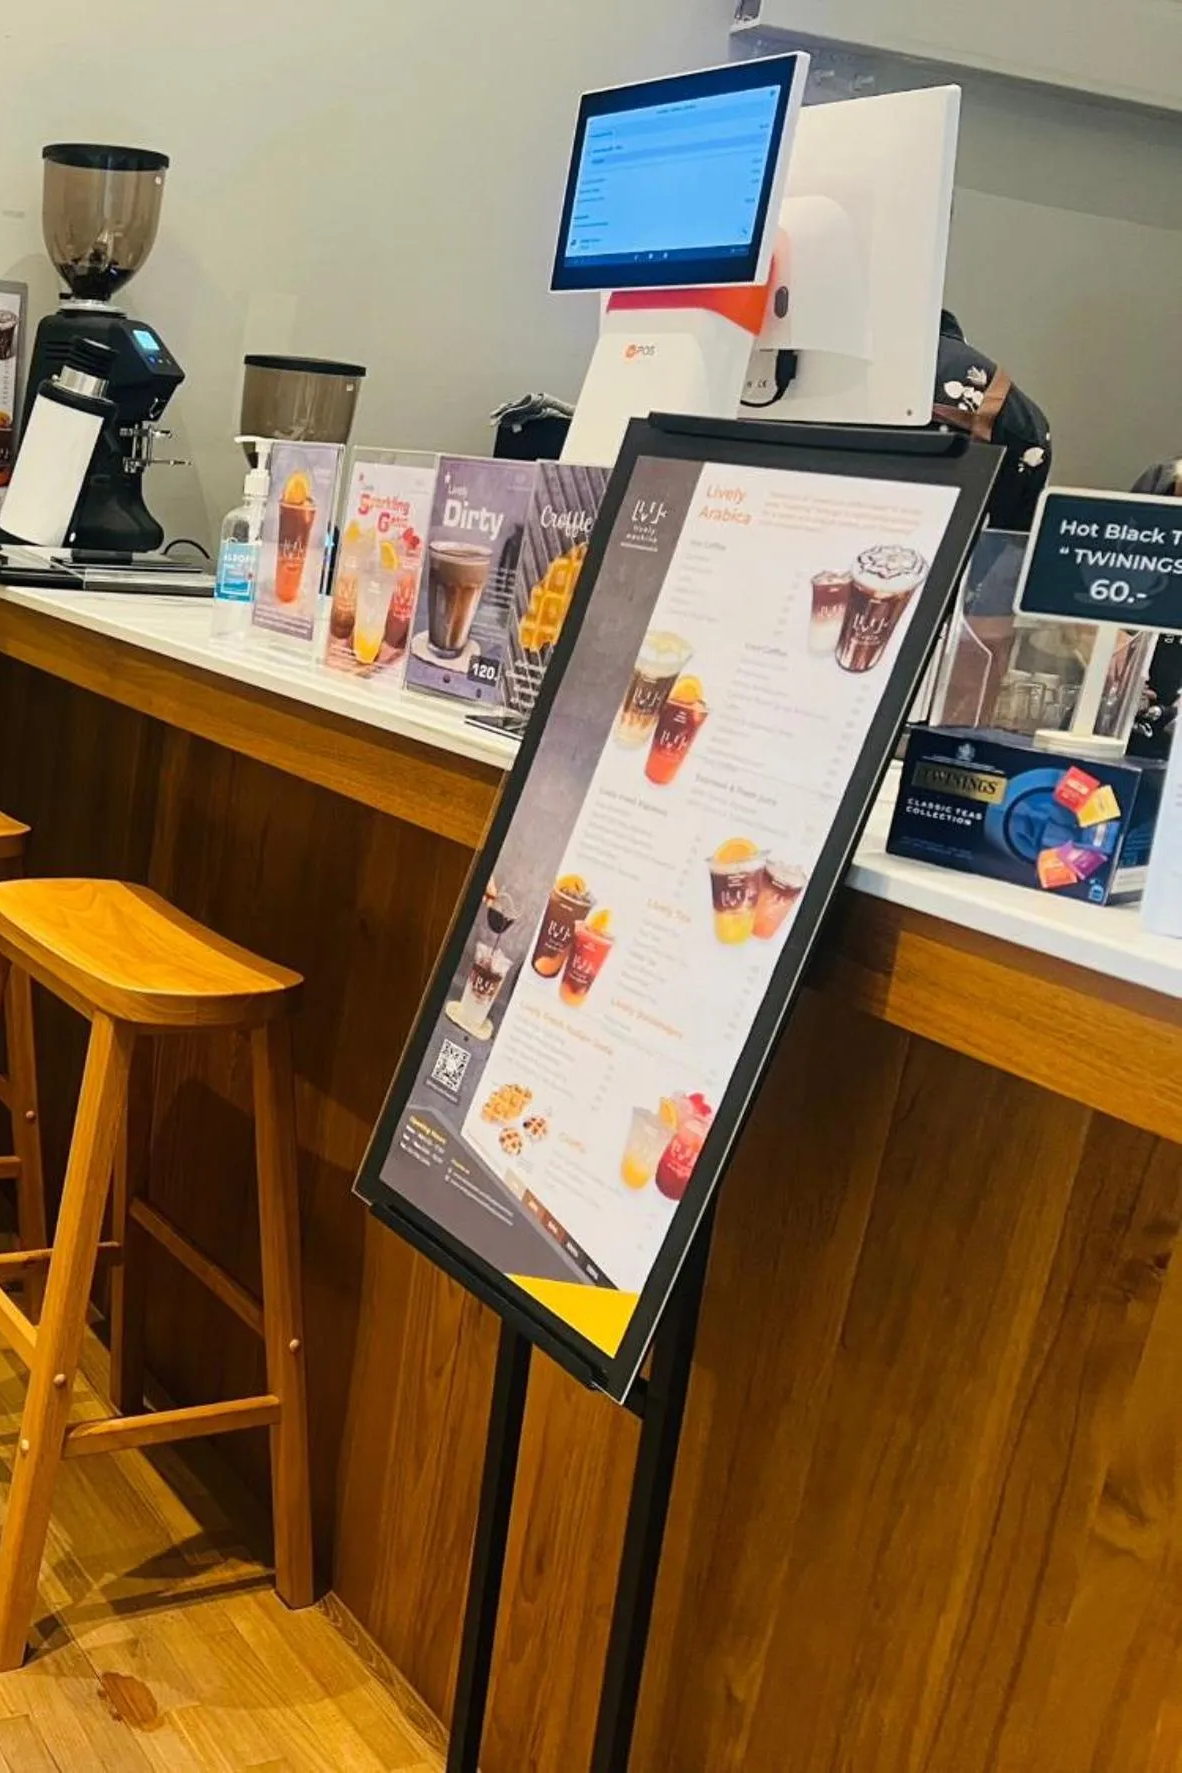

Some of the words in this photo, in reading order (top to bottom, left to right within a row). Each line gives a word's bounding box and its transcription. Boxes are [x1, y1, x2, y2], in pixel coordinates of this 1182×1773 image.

[706, 485, 747, 505] Lively
[443, 499, 505, 540] Dirty
[540, 504, 594, 538] Croffle
[699, 505, 753, 526] Arabica
[1060, 519, 1099, 538] Hot
[1104, 523, 1166, 544] Black
[1089, 578, 1148, 604] 60.-
[923, 768, 999, 795] TWININGS
[905, 805, 972, 827] COLLECTION
[906, 797, 952, 814] CLASSIC
[955, 807, 983, 821] TEAS
